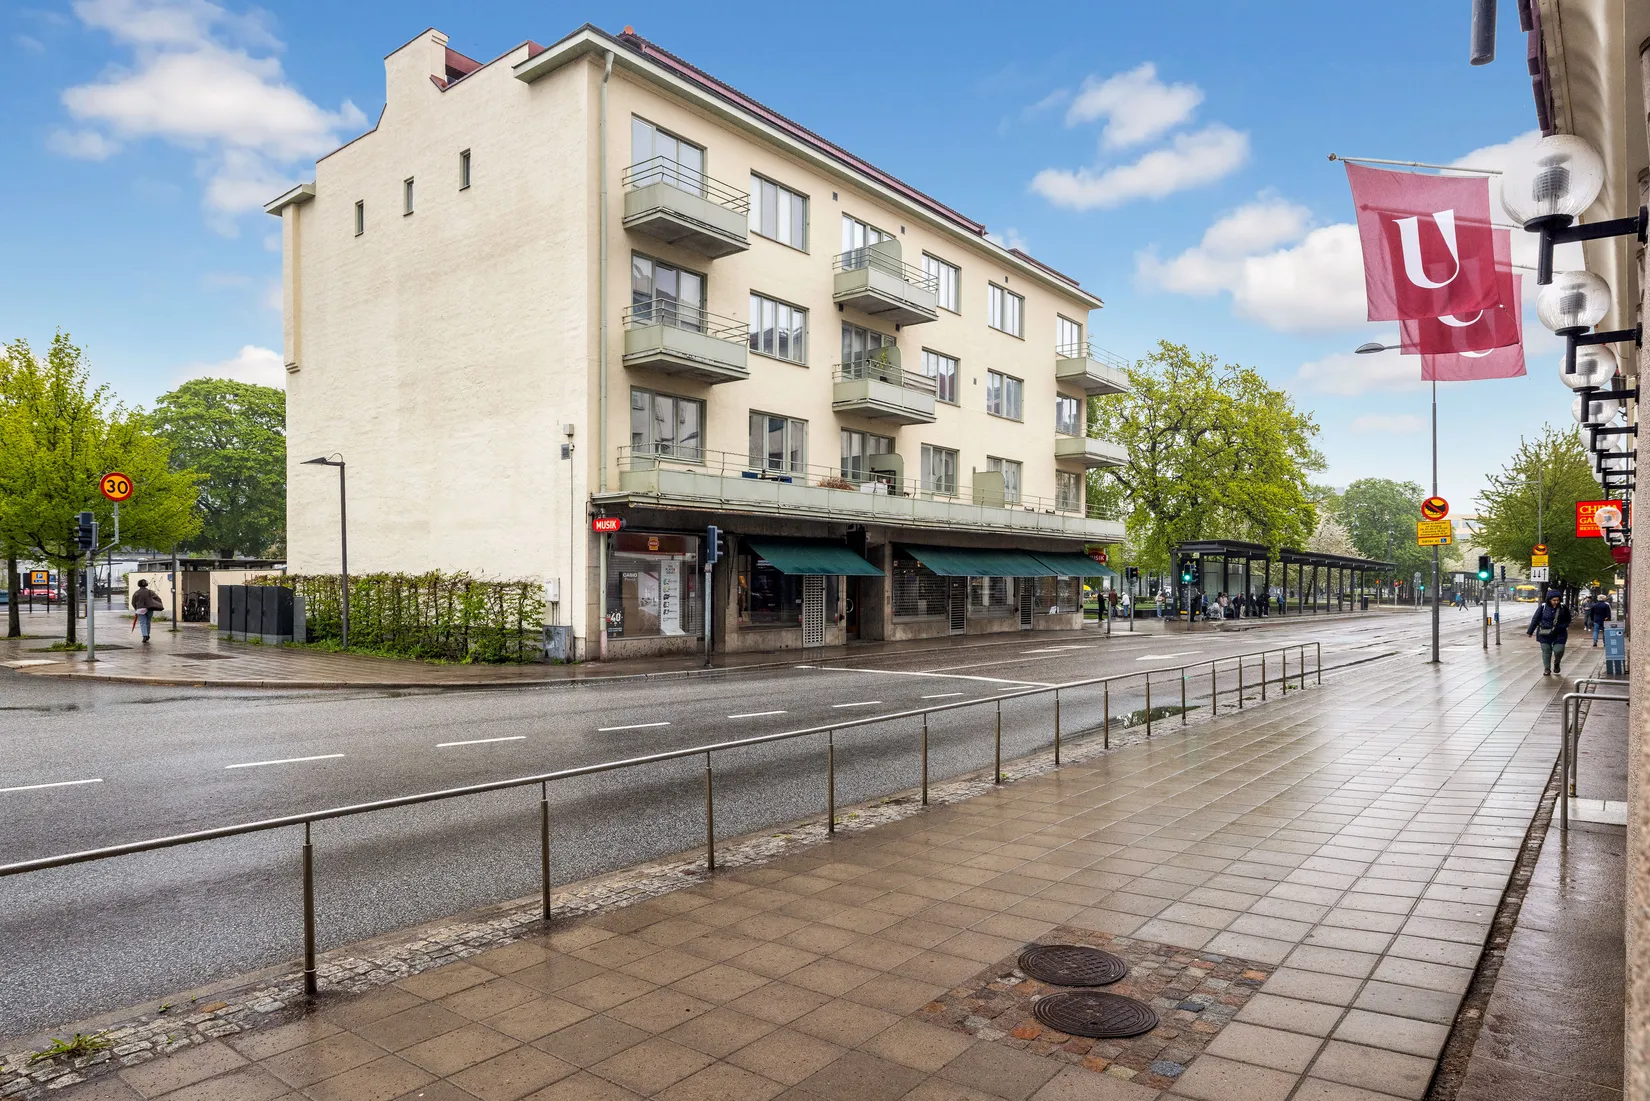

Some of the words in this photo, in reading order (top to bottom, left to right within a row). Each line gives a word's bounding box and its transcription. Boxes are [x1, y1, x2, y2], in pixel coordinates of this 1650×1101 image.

[1392, 209, 1460, 289] U
[106, 479, 129, 494] 30
[1579, 504, 1618, 514] CHI
[596, 520, 616, 530] MUSIK
